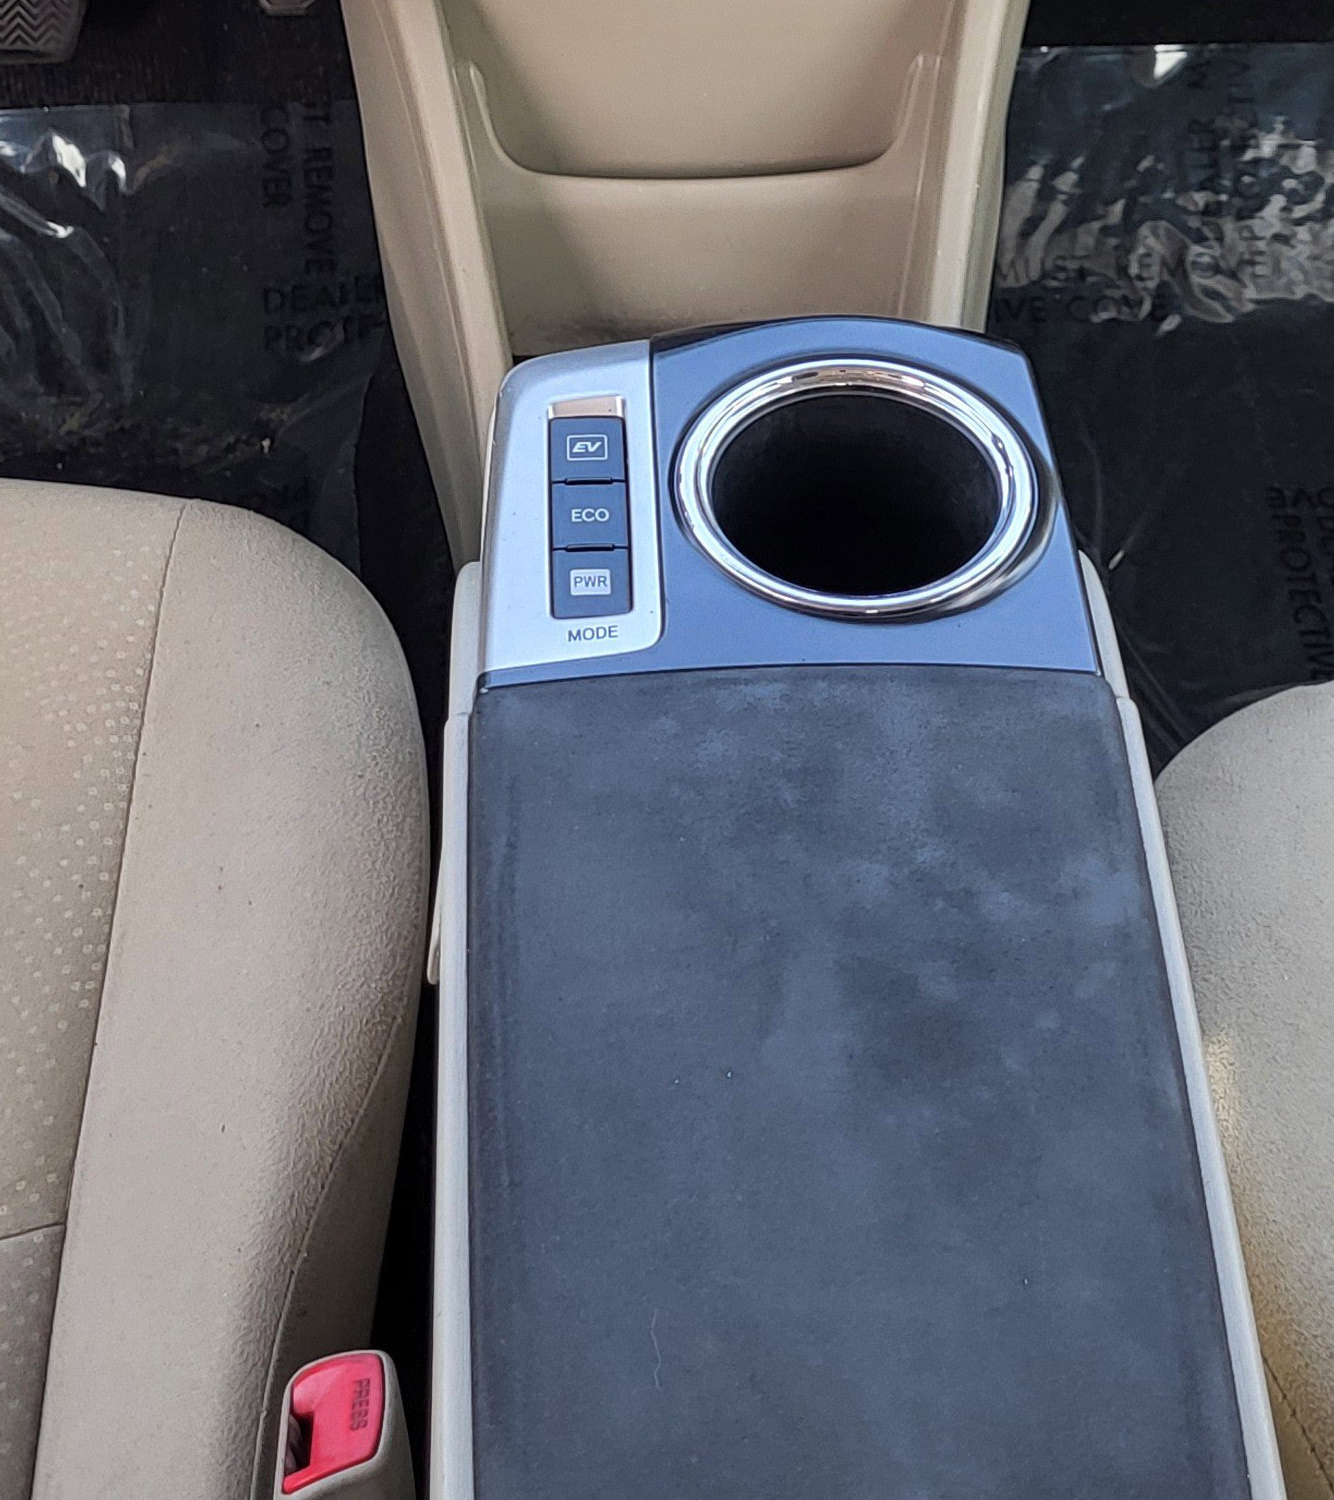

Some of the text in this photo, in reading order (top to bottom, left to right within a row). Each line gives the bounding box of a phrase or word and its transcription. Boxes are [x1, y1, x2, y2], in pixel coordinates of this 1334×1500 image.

[572, 441, 602, 453] EV
[571, 508, 610, 522] ECO
[573, 575, 608, 588] PWR
[567, 625, 619, 642] MODE
